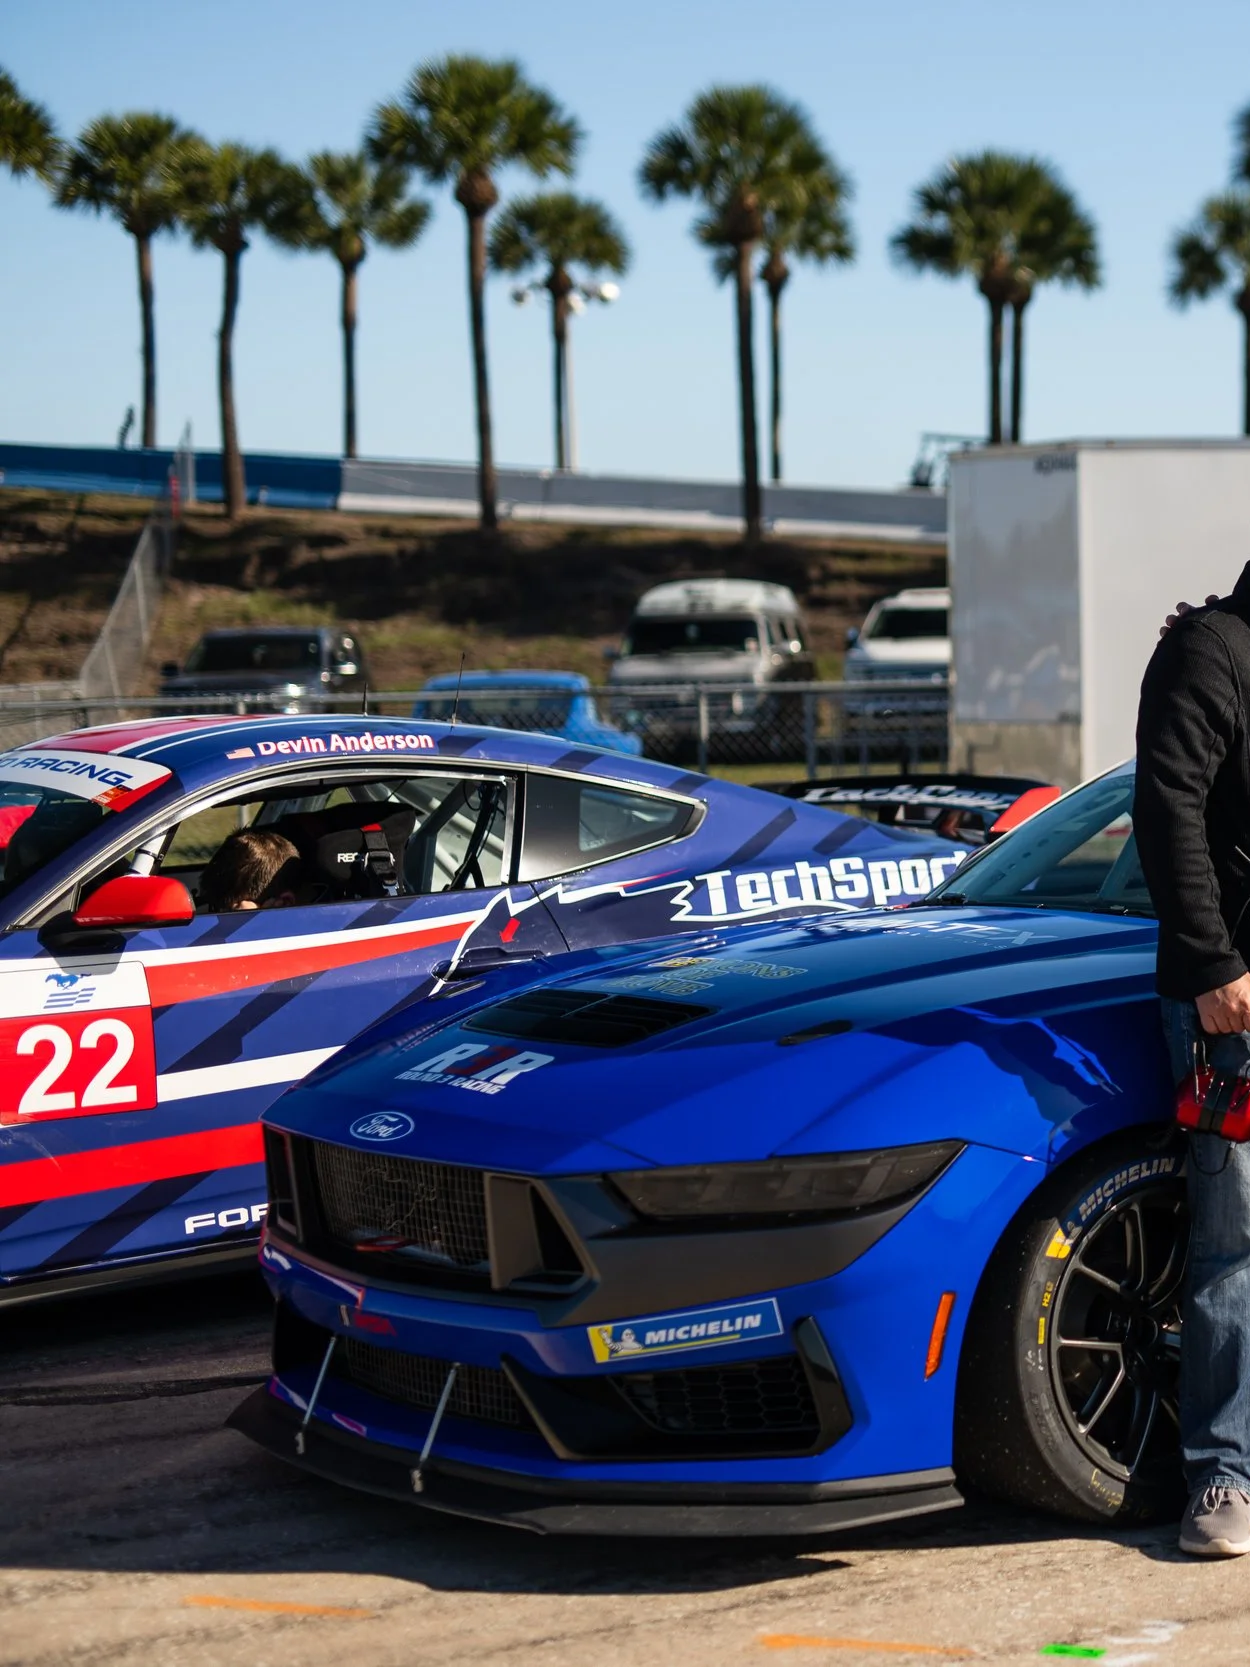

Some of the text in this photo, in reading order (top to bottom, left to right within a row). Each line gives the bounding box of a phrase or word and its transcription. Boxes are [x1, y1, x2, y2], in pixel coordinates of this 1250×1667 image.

[257, 732, 435, 755] Devin Anderson
[16, 757, 134, 786] RACING
[16, 1017, 138, 1115] 22
[409, 1043, 556, 1086] R3R
[448, 1077, 507, 1095] RACING
[356, 1114, 403, 1138] Ford
[1078, 1155, 1176, 1222] MICHELIN
[645, 1313, 762, 1345] MICHELIN
